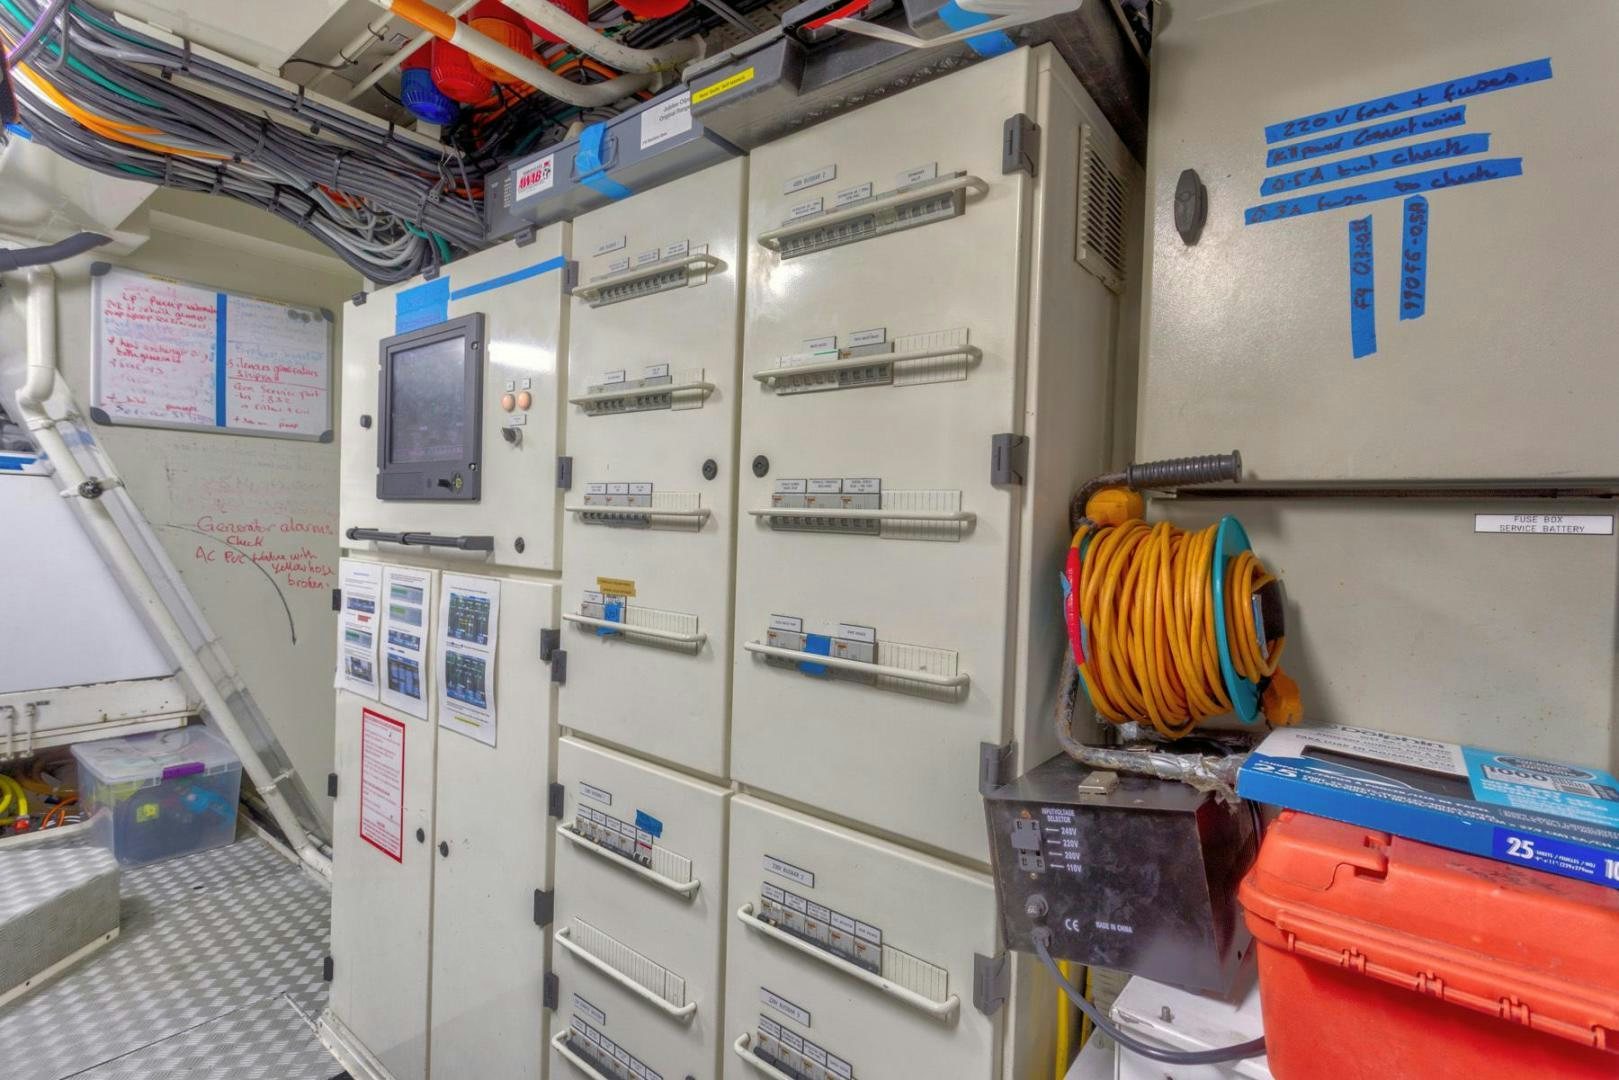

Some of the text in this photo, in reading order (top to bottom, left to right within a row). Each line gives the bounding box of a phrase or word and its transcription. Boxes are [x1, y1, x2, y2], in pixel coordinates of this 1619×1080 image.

[1513, 515, 1563, 523] FUSE BOX
[1499, 524, 1586, 534] SERVICE BATTERY
[1251, 762, 1299, 779] 25
[1062, 839, 1079, 848] 220V
[1505, 837, 1535, 860] 25
[1066, 863, 1082, 873] 110V
[1095, 921, 1134, 934] MADE IN CHINA
